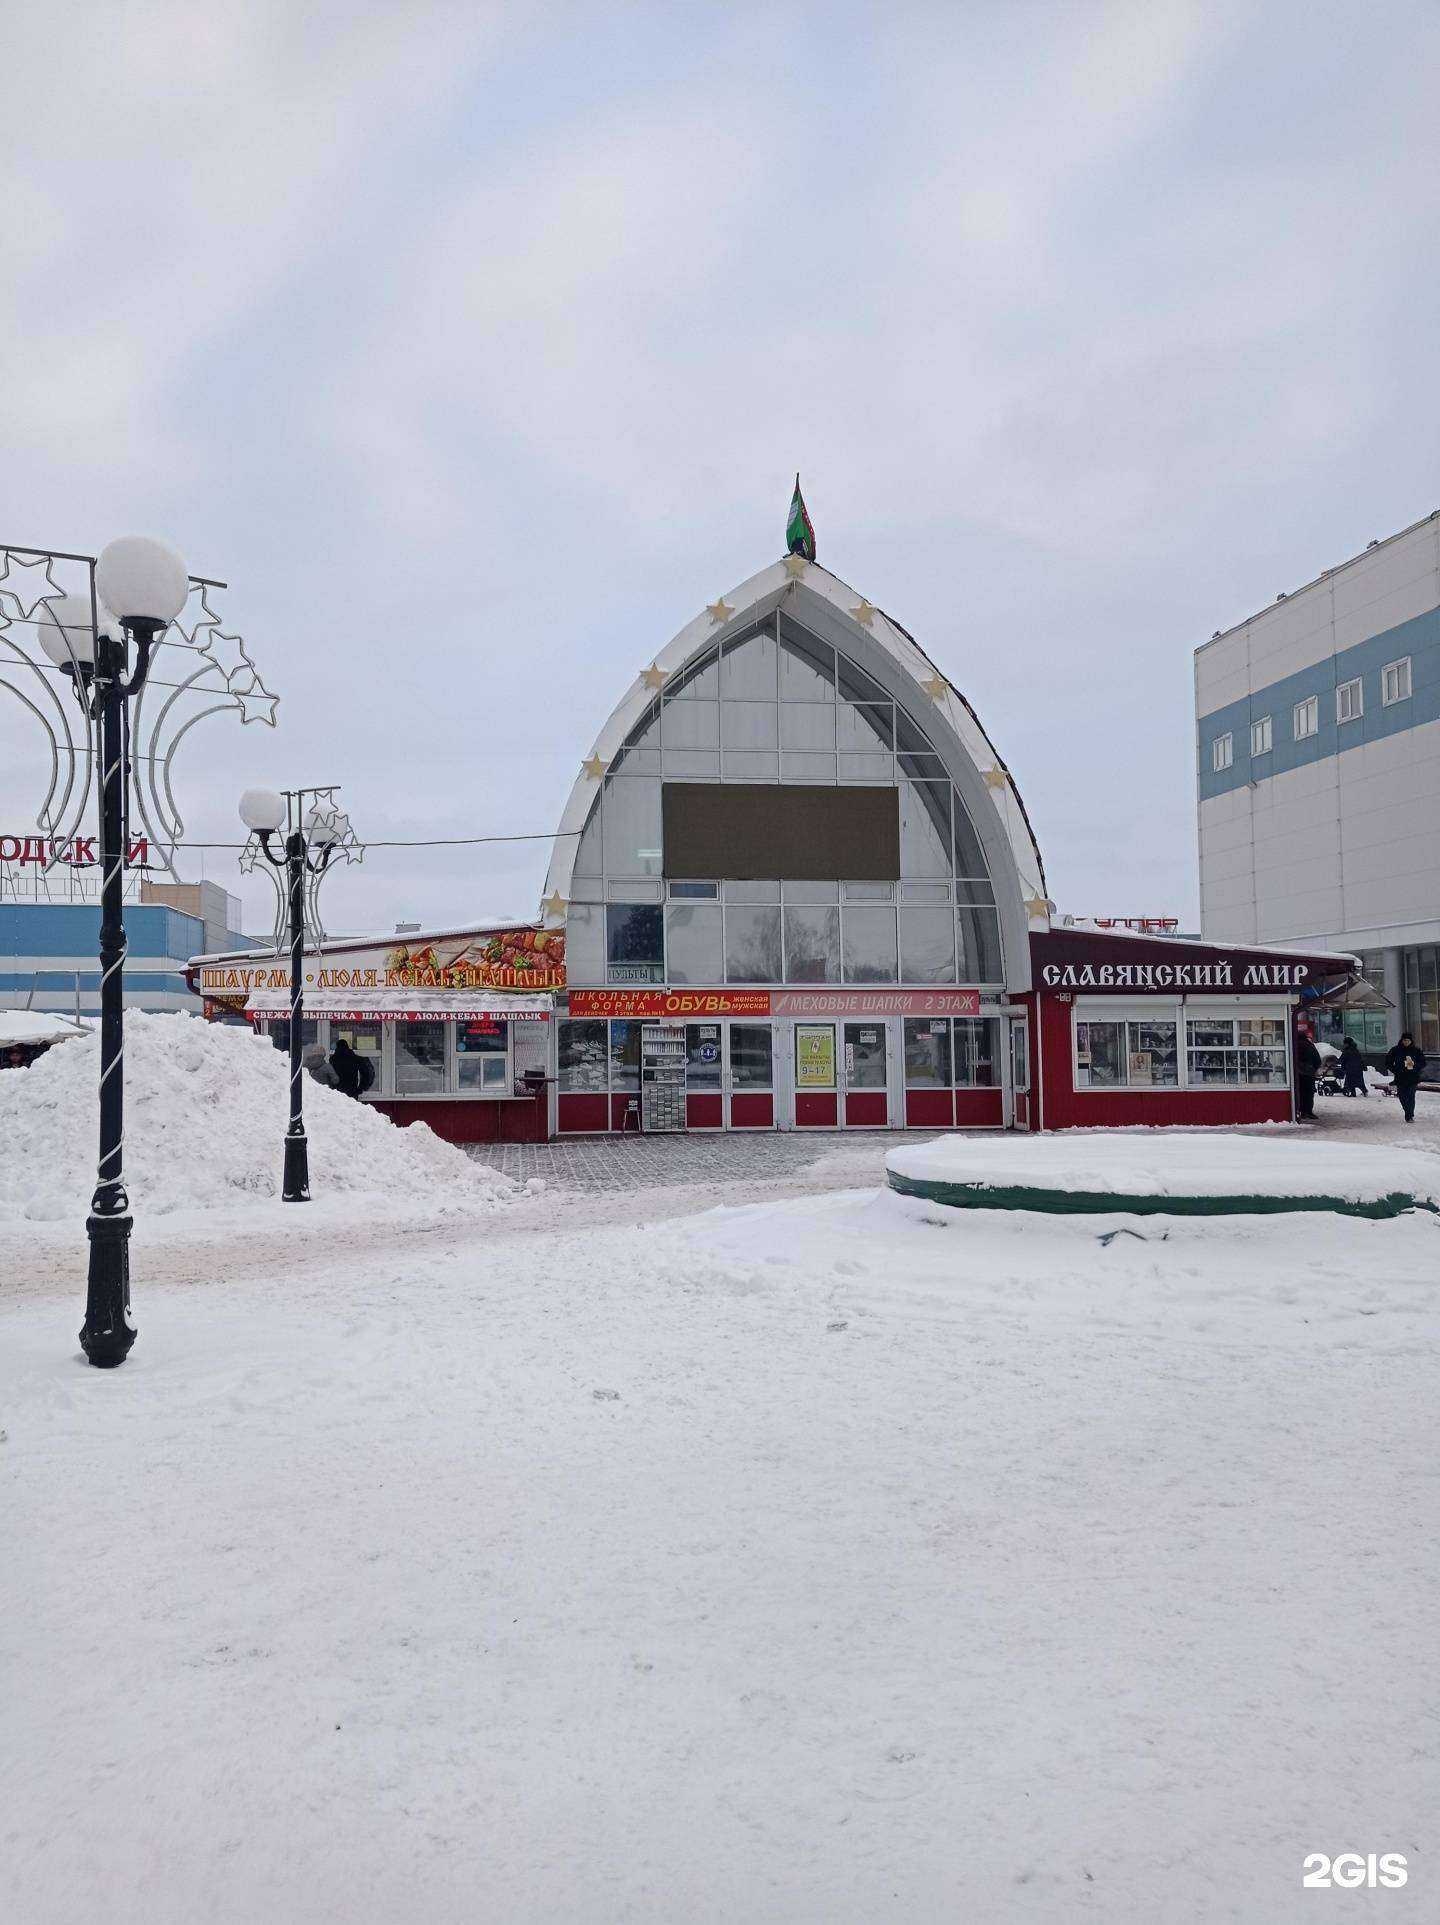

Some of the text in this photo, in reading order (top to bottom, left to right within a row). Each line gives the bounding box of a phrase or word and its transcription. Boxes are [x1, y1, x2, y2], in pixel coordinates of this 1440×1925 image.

[0, 831, 148, 867] ОДСКЙ
[1042, 960, 1309, 987] СЛАВЯНСКИЙ МИР
[202, 968, 293, 993] ШАУРМ
[573, 991, 664, 1001] ШКОЛЬНАЯ
[731, 995, 769, 1003] женская
[789, 994, 857, 1010] МЕХОВЫЕ
[861, 994, 913, 1010] ШАПКИ
[924, 995, 934, 1009] 2
[937, 994, 974, 1009] ЭТАЖ
[590, 1001, 646, 1011] ФОРМА
[665, 995, 731, 1012] ОБУВЬ
[731, 1002, 769, 1010] мужская
[252, 1010, 542, 1021] СВЕЖА ВЫПЕЧКА ШАУРМА ЛЮЛЯ-КЕБАБ ШАШЛЫК
